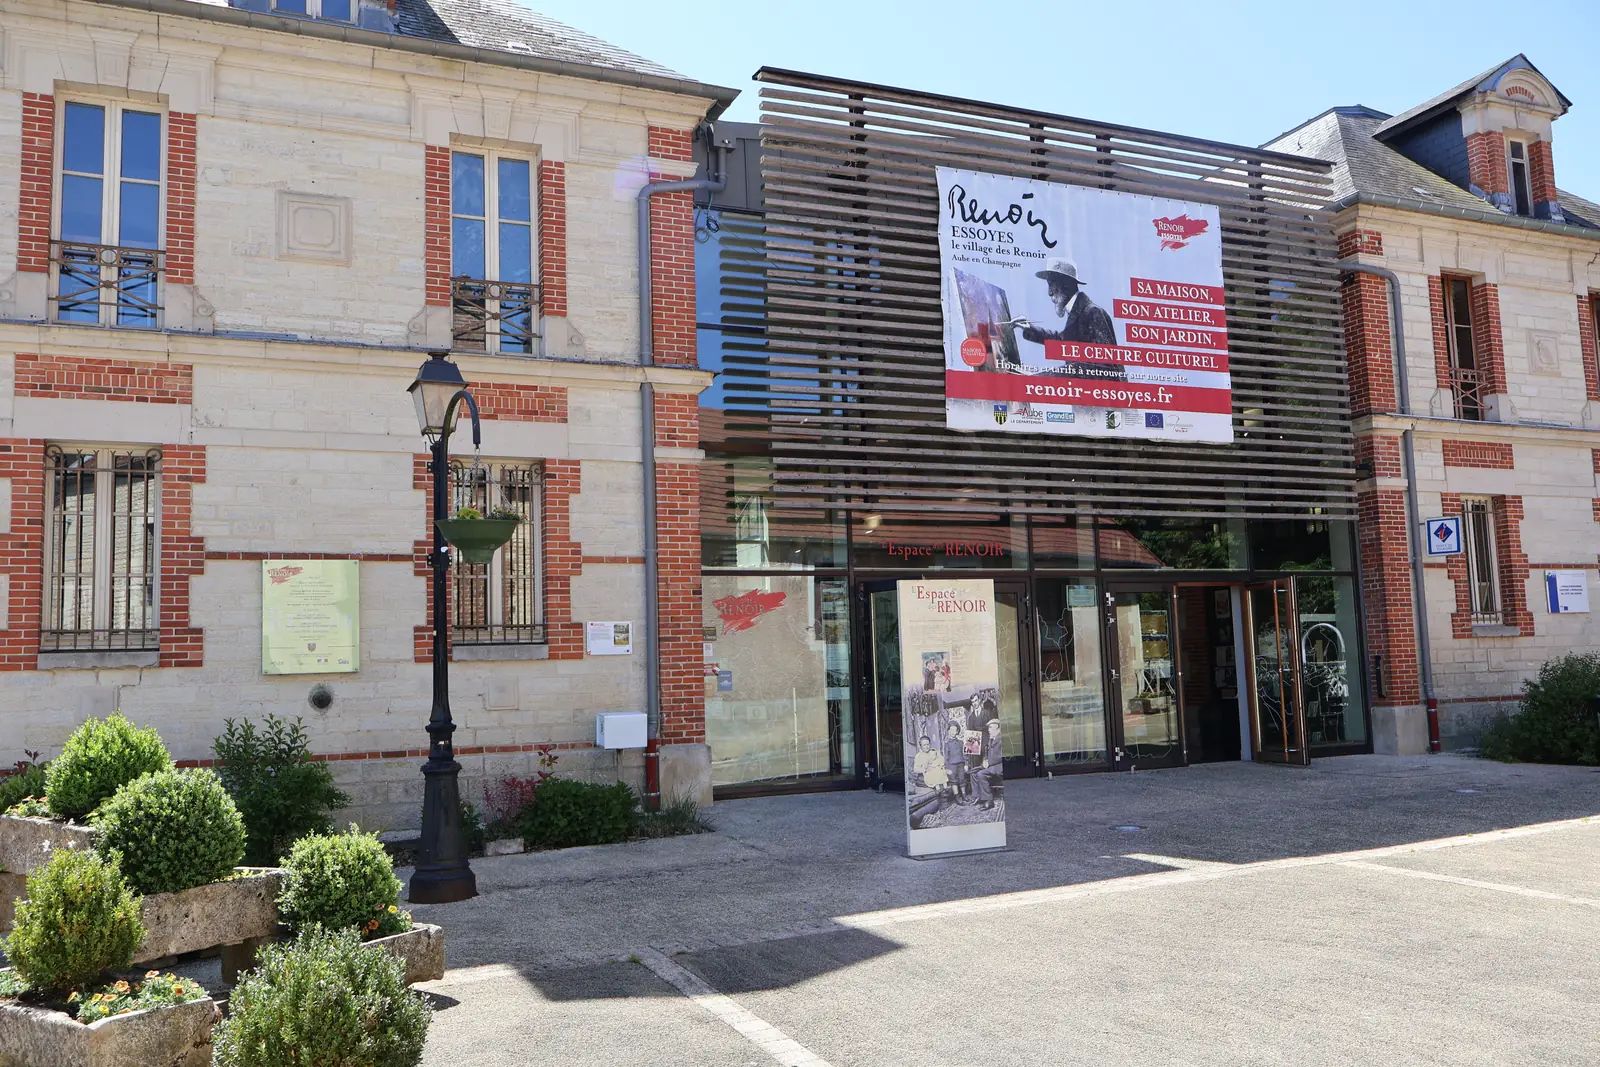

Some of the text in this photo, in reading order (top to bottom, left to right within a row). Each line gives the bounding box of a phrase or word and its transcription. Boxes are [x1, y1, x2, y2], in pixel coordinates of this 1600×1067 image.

[951, 226, 1014, 243] ESSOYES
[1158, 221, 1185, 233] RENOIR
[951, 240, 1047, 259] le village des Renoir
[952, 254, 970, 262] Aube
[982, 256, 1022, 269] Champagne
[1137, 281, 1214, 303] SA MAISON,
[1121, 303, 1215, 325] SON ATELIER,
[1131, 326, 1216, 347] SON JARDIN,
[1061, 344, 1219, 369] LE CENTRE CULTUREL
[995, 359, 1038, 372] Horaires
[1051, 364, 1076, 375] tarifs
[1078, 365, 1084, 375] à
[1086, 368, 1128, 378] retrouver
[1130, 372, 1146, 380] sur
[1147, 373, 1171, 382] notre
[1173, 374, 1189, 383] site
[1025, 381, 1173, 407] renoir-essoyes.fr
[1021, 407, 1044, 418] Aube
[945, 541, 1004, 556] RENOIR
[937, 600, 987, 613] RENOIR
